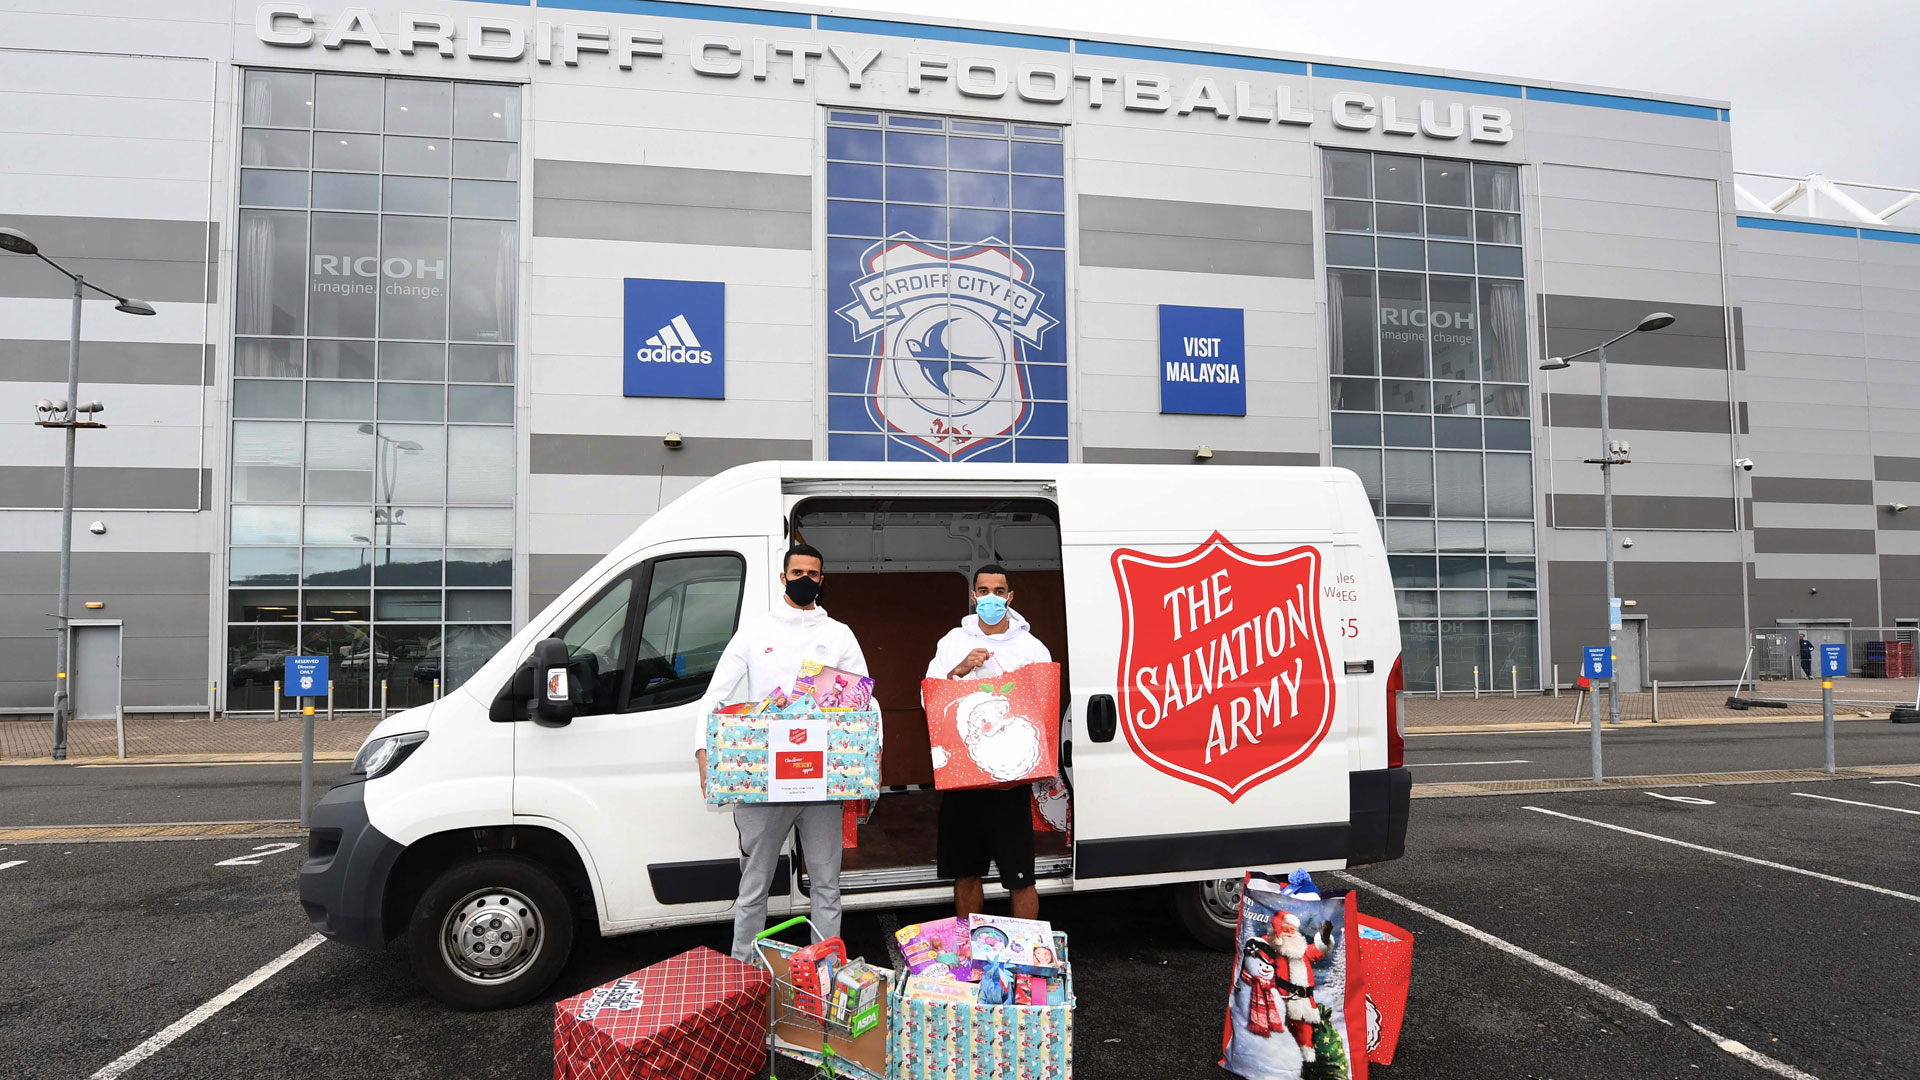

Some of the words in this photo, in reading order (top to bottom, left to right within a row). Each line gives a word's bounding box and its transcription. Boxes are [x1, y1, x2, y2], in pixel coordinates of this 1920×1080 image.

[256, 2, 664, 71] CARDIFF
[690, 34, 882, 89] CITY
[907, 52, 1314, 126] FOOTBALL
[1332, 91, 1514, 144] CLUB
[314, 254, 445, 280] RICOH
[313, 280, 377, 296] imagine.
[385, 282, 444, 299] change.
[869, 273, 951, 302] CARDIFF
[957, 275, 1001, 298] CITY
[1003, 289, 1028, 310] FC
[1380, 307, 1475, 330] RICOH
[637, 345, 713, 365] adidas
[1183, 337, 1221, 358] VISIT
[1166, 361, 1240, 384] MALAYSIA
[1163, 568, 1233, 642] THE
[1135, 583, 1309, 730] SALVATION
[1204, 657, 1303, 765] ARMY
[856, 1011, 877, 1032] ASDA
